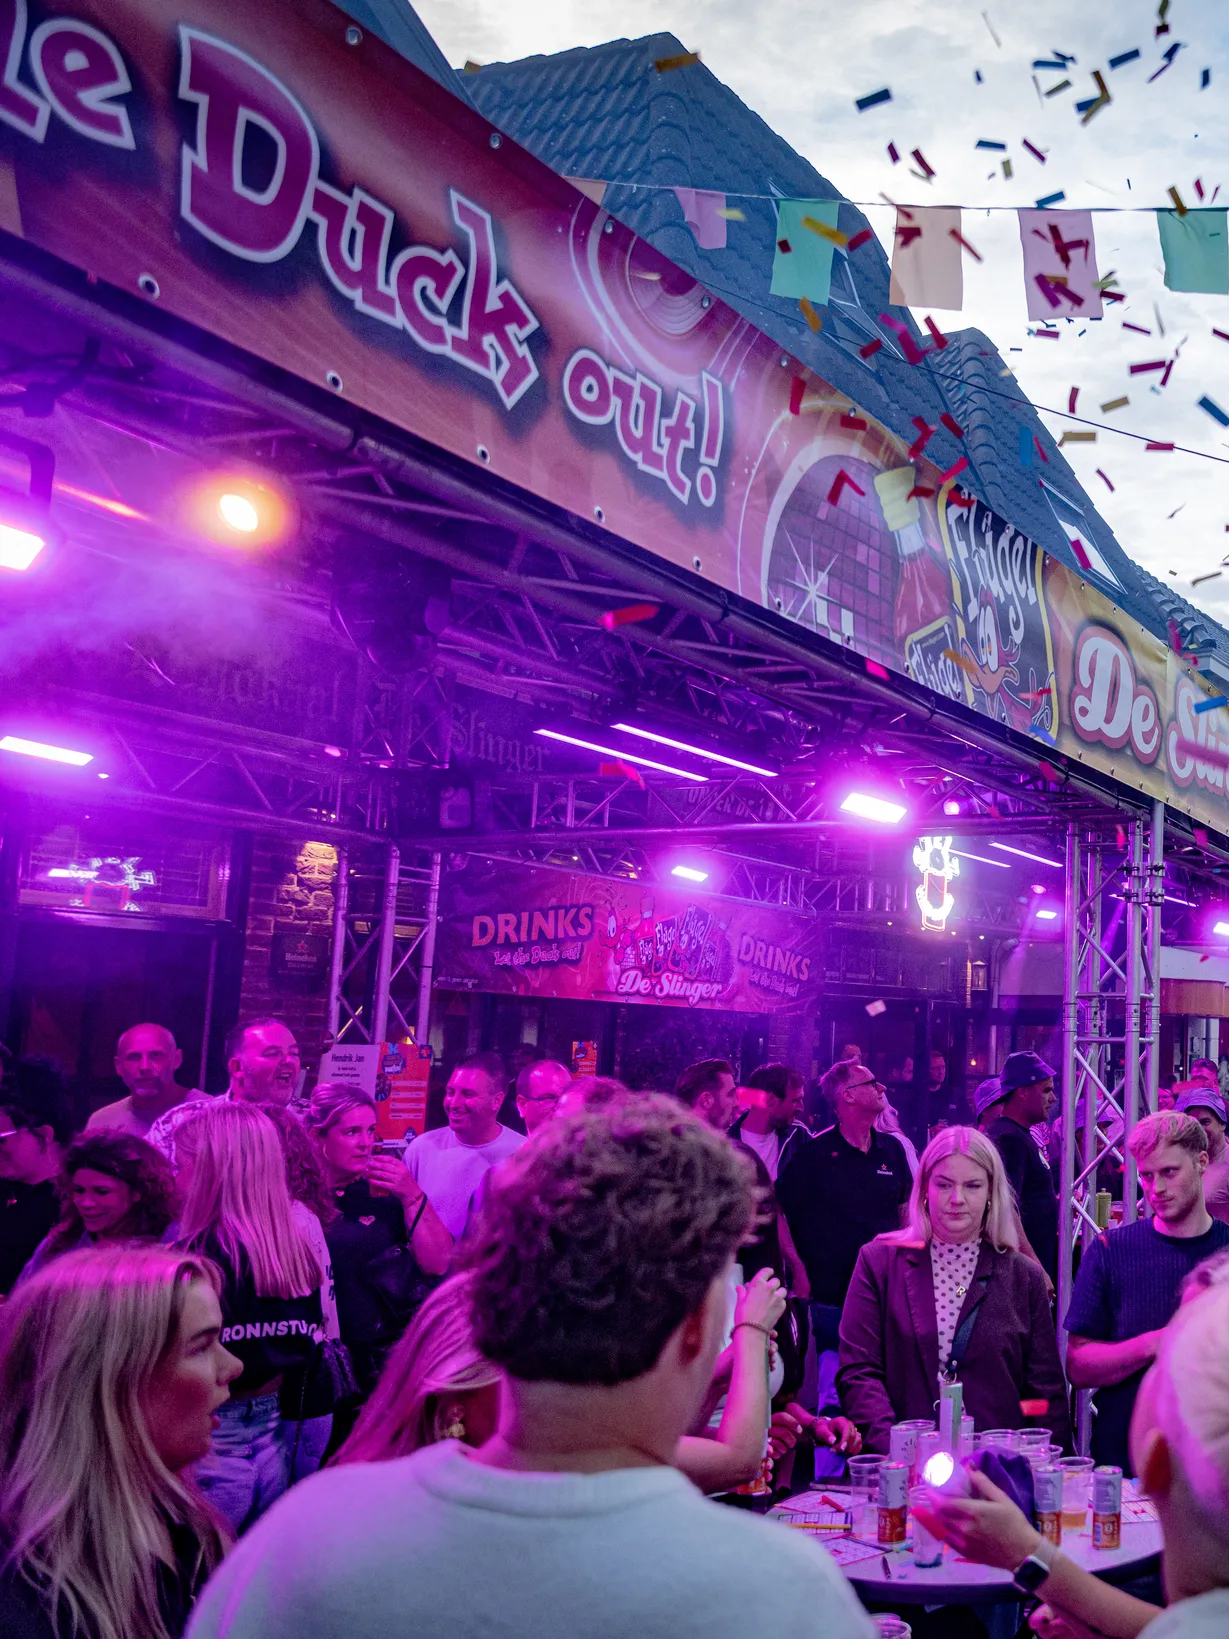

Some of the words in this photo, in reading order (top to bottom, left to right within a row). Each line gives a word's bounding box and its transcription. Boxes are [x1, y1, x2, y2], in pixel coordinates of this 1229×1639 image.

[178, 24, 540, 409] Duck
[563, 349, 724, 507] out!
[1073, 636, 1160, 756] De
[472, 906, 593, 947] DRINKS
[531, 943, 560, 964] Duck
[738, 934, 811, 981] DRINKS
[618, 970, 650, 995] De
[655, 972, 723, 1005] Slinger
